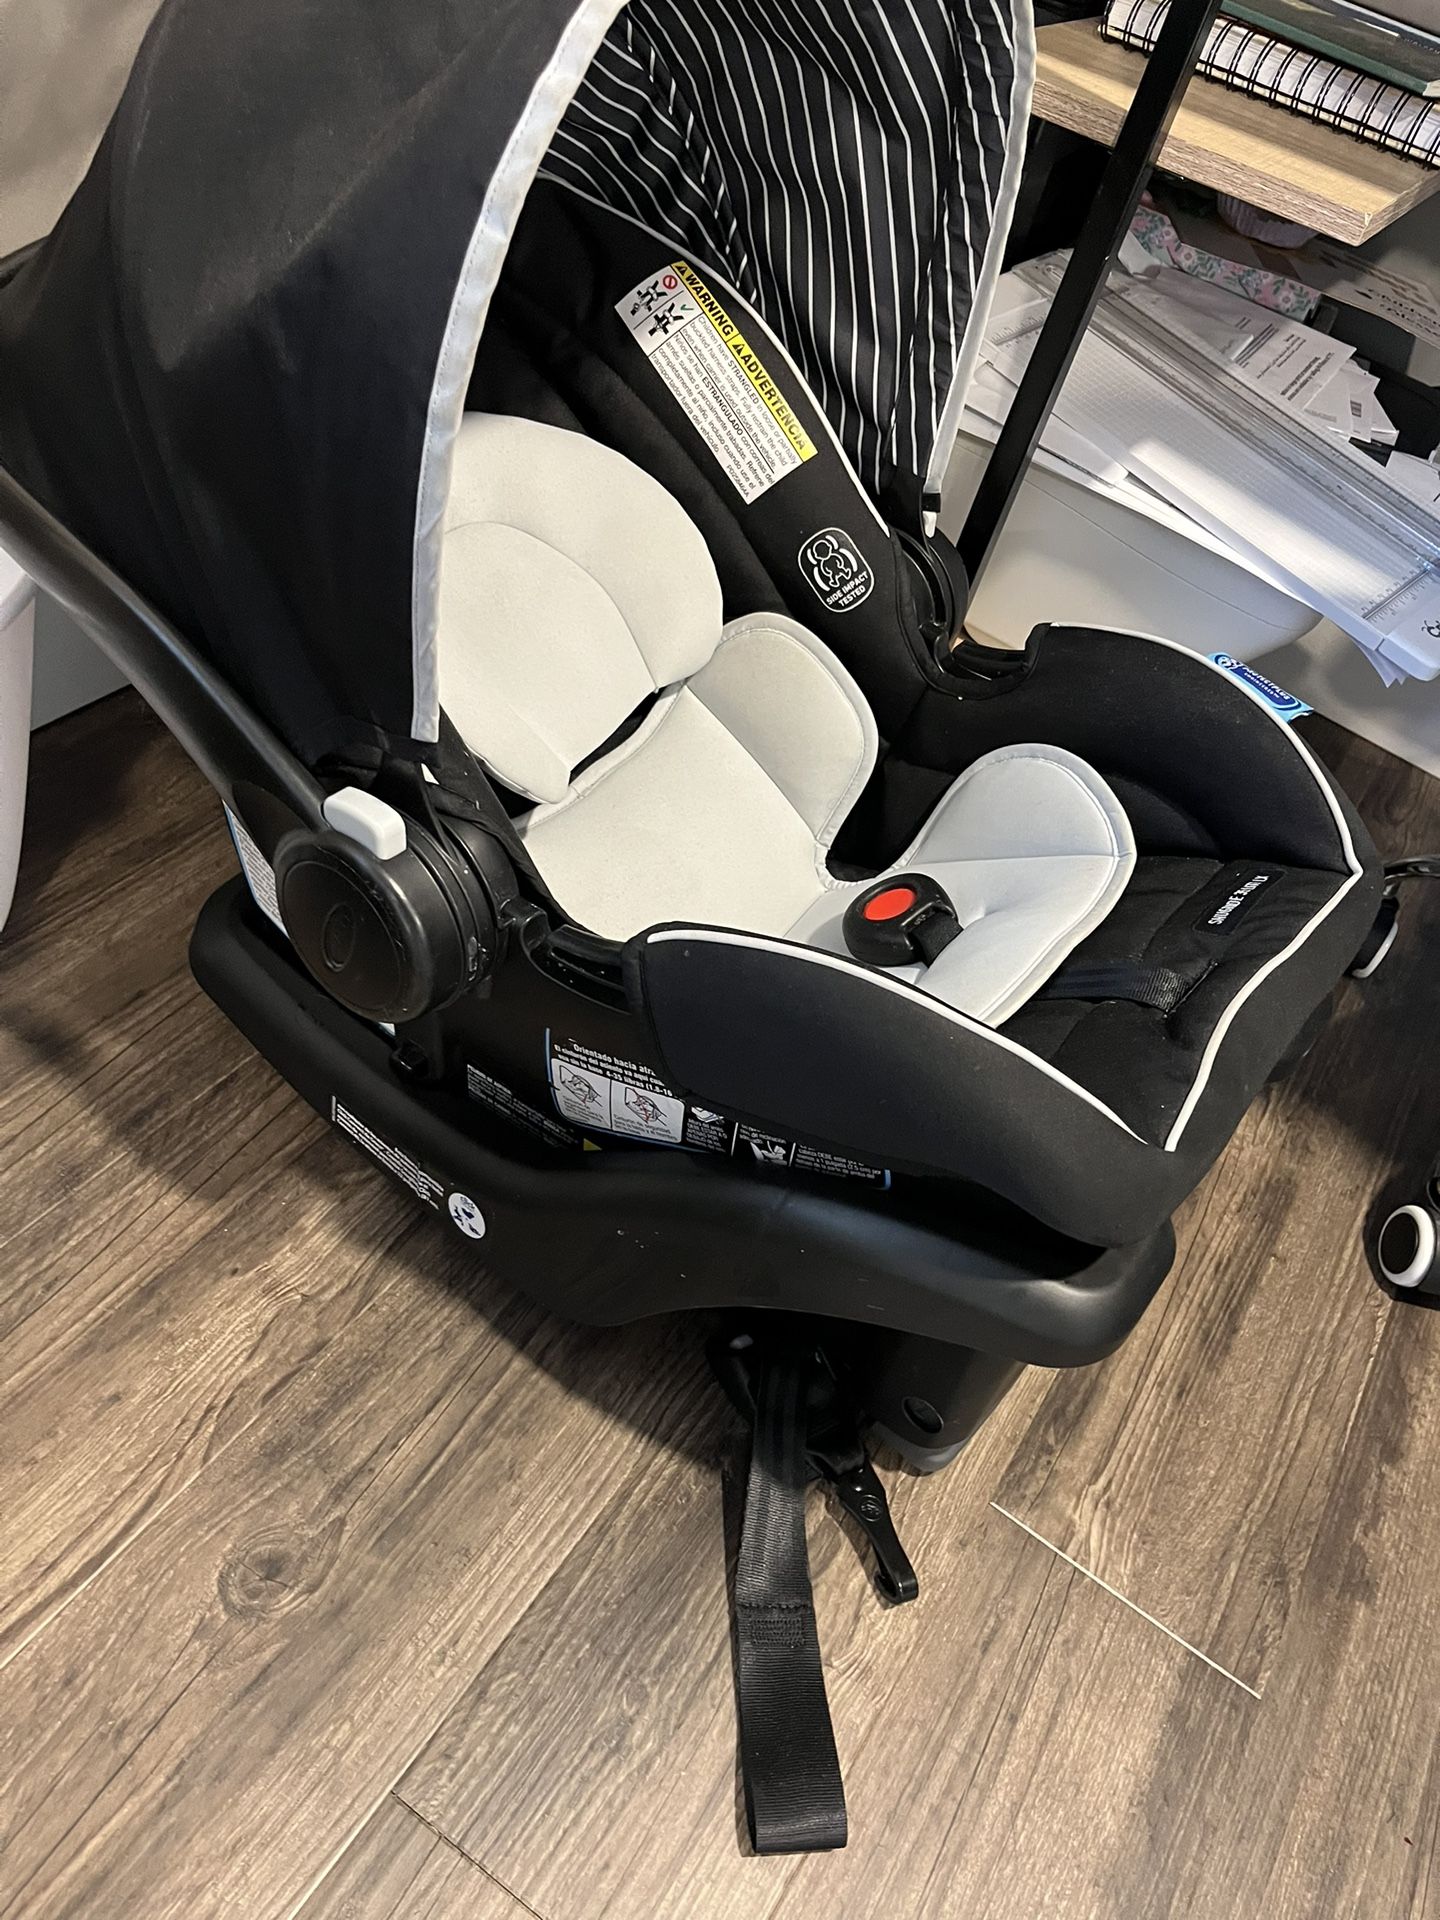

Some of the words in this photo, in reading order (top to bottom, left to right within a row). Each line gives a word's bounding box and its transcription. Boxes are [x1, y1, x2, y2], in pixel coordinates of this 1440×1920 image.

[698, 315, 719, 343] Children
[684, 273, 734, 336] WARNING
[739, 351, 809, 449] ADVERTENCIA
[716, 343, 731, 361] have
[649, 352, 684, 399] transportador
[679, 396, 695, 416] fuera
[691, 413, 703, 426] del
[689, 321, 710, 348] buckled
[706, 348, 727, 375] harness
[738, 396, 753, 414] Fully
[749, 412, 769, 438] restrain
[766, 437, 777, 450] the
[773, 448, 788, 466] child
[727, 359, 759, 404] STRANGLED
[665, 340, 681, 361] arnés
[678, 359, 697, 384] sueltas
[696, 388, 729, 432] parcialmente
[725, 430, 748, 460] trabadas.
[745, 460, 766, 487] Refrene
[672, 333, 690, 355] Niños
[685, 354, 694, 364] se
[691, 362, 705, 377] han
[701, 376, 743, 436] ESTRANGULADO
[739, 435, 751, 449] con
[748, 448, 768, 474] correas
[764, 472, 776, 485] del
[681, 327, 694, 344] even
[692, 344, 707, 363] when
[705, 362, 722, 384] carrier
[719, 383, 726, 391] is
[723, 390, 738, 408] used
[734, 407, 754, 433] outside
[750, 431, 761, 444] the
[758, 443, 778, 469] vehicle.
[756, 403, 764, 412] in
[656, 346, 694, 398] completamente
[691, 396, 699, 404] al
[707, 420, 726, 445] incluso
[722, 443, 742, 470] cuando
[739, 469, 750, 482] use
[747, 481, 755, 489] el
[761, 410, 777, 430] loose
[773, 430, 780, 438] or
[776, 437, 798, 465] partially
[825, 589, 843, 604] SIDE
[841, 570, 869, 593] IMPACT
[838, 584, 866, 606] TESTED
[572, 1043, 612, 1063] Orientado
[613, 1057, 637, 1070] hacia
[605, 1071, 623, 1081] 4-35
[623, 1076, 644, 1088] libras
